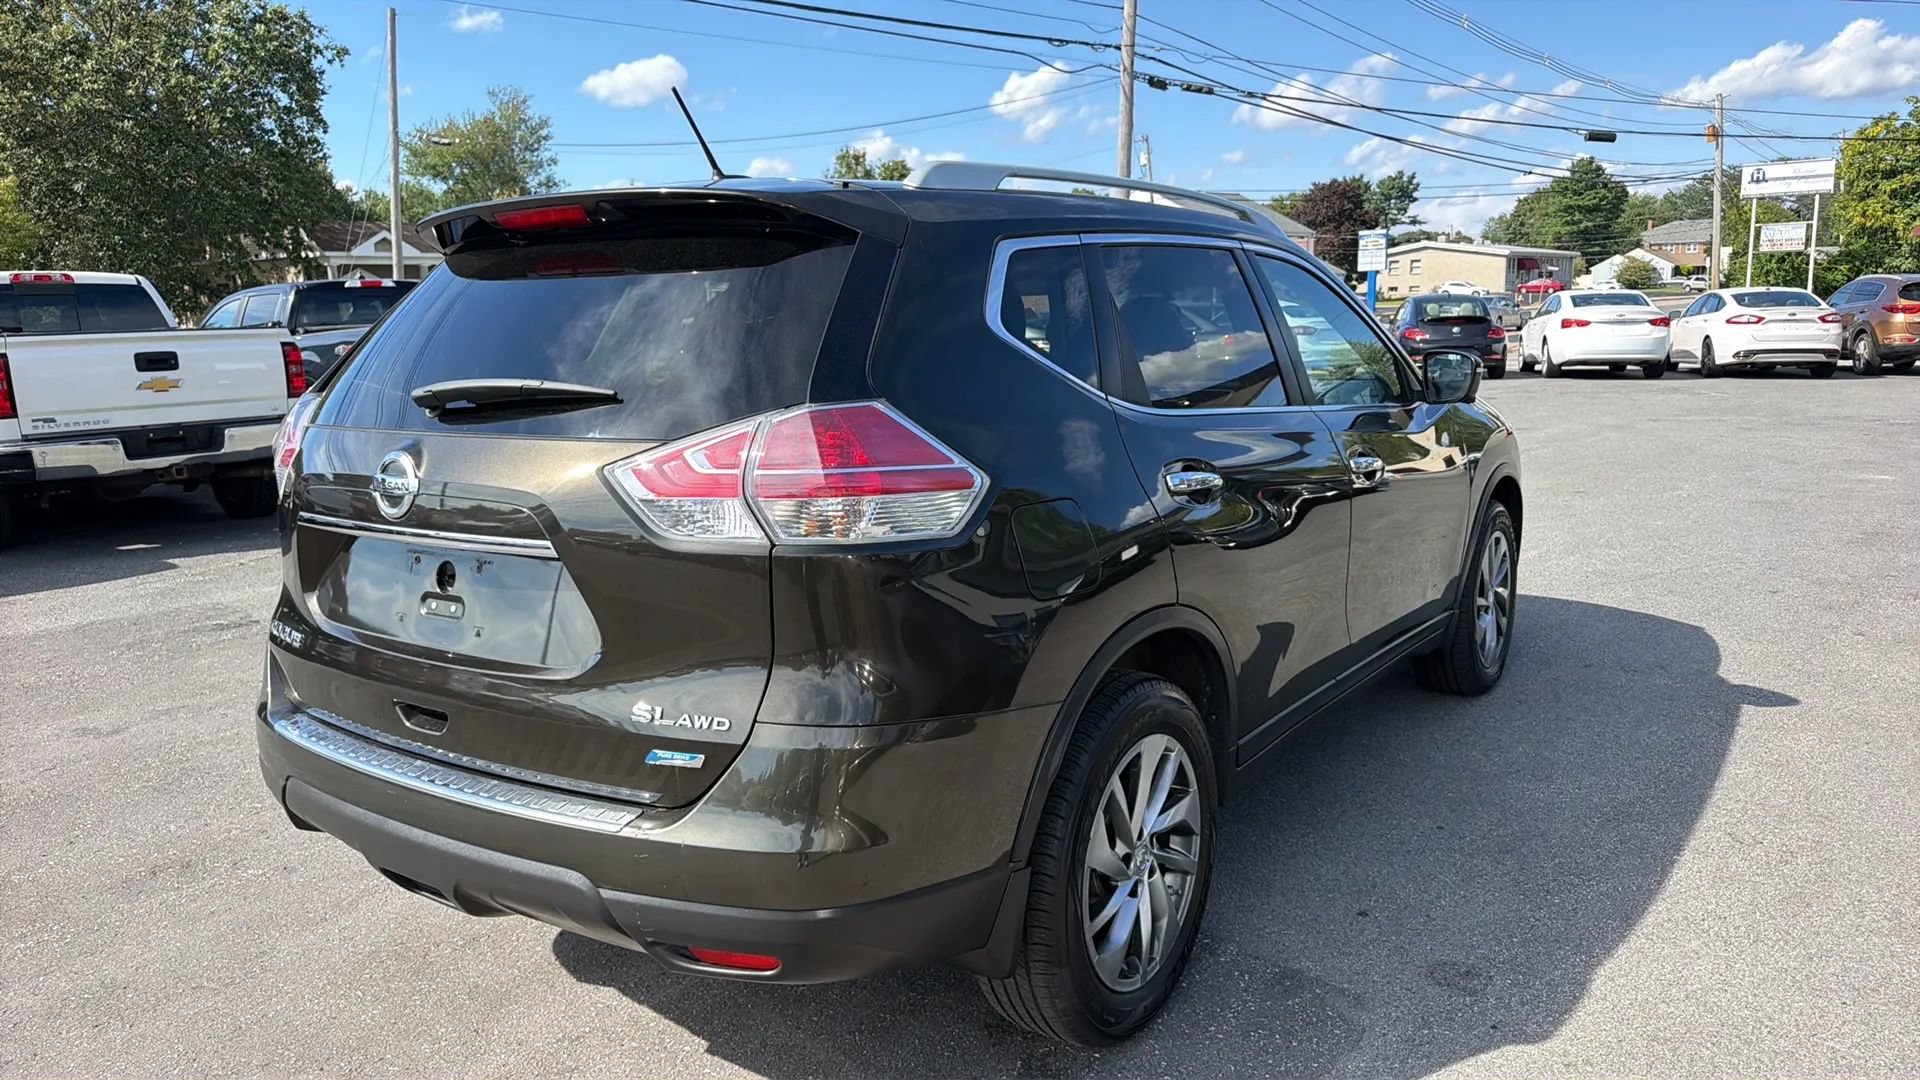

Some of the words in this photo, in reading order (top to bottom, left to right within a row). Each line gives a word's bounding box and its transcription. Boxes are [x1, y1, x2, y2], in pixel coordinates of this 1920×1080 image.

[31, 419, 110, 430] SILVERADO
[374, 477, 410, 491] NISSAN
[630, 701, 675, 725] SL
[674, 713, 731, 732] AWD
